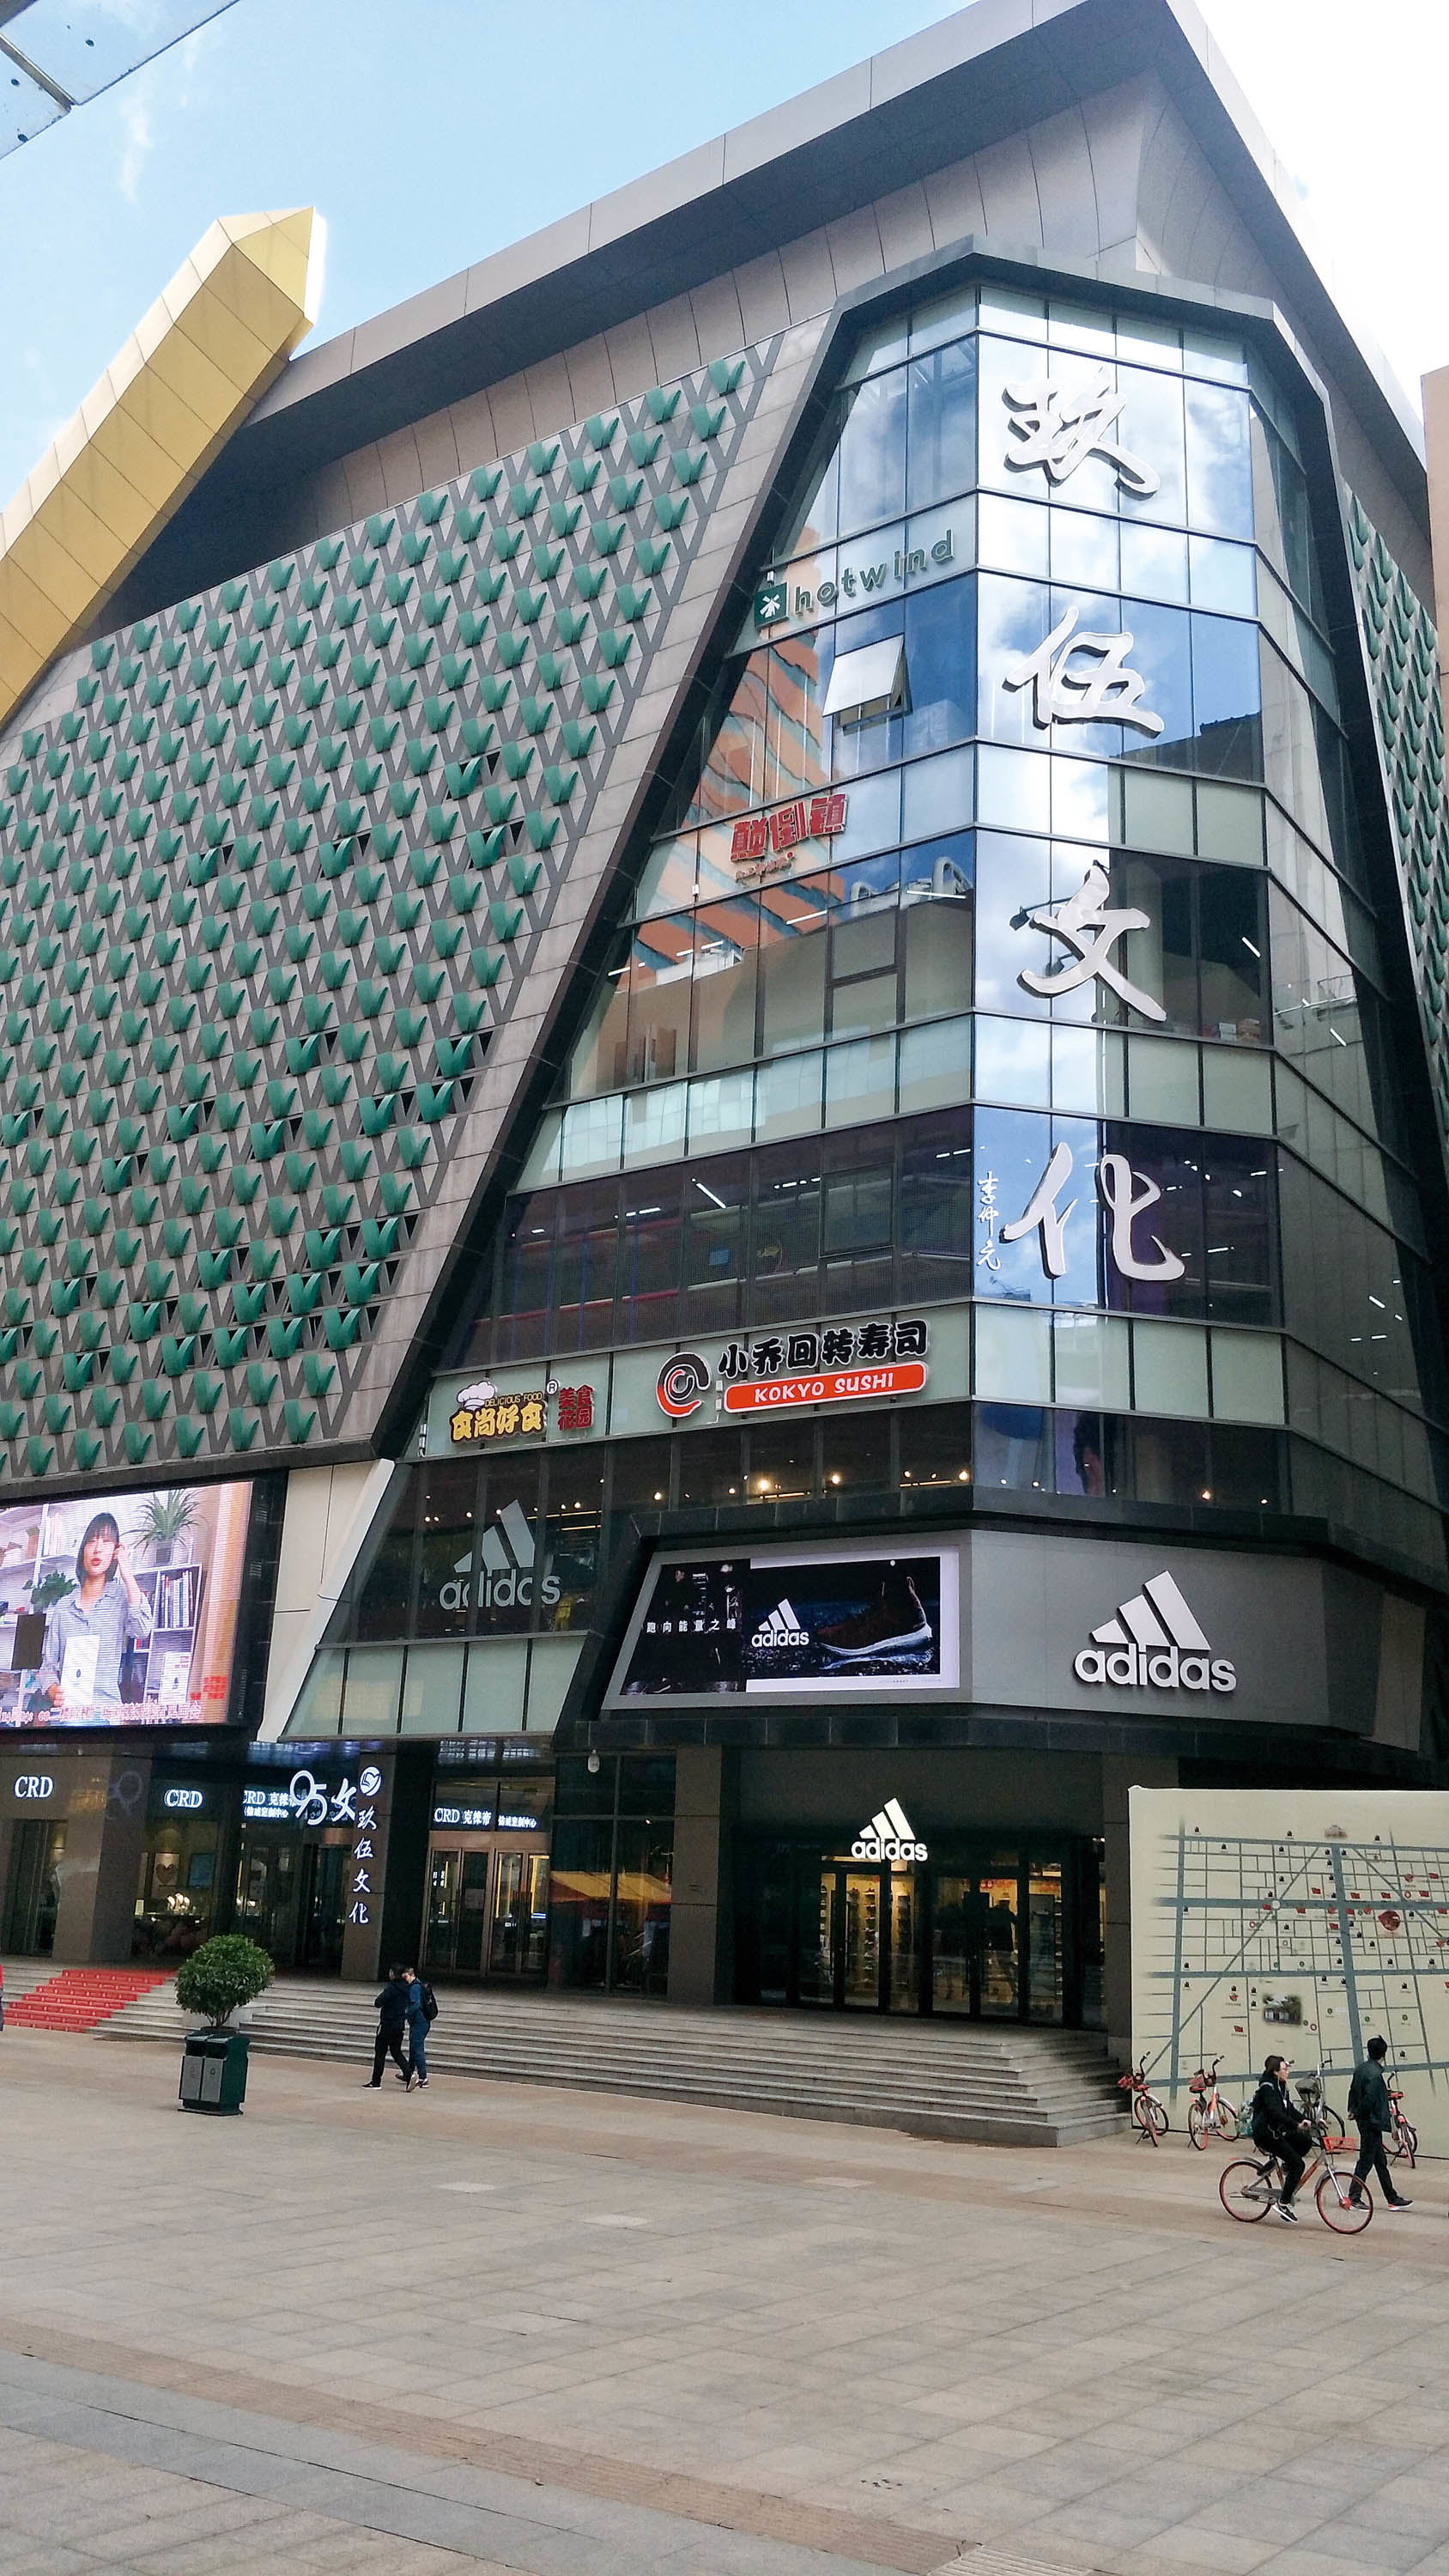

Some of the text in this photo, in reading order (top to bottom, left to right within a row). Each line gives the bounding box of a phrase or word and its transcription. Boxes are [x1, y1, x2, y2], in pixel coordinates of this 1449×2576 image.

[795, 529, 955, 616] hotwind
[718, 1320, 928, 1378] 小乔回转寿司
[484, 1392, 543, 1407] DELICIOUS FOOD
[755, 1373, 894, 1402] KOKYO SUSHI
[452, 1401, 543, 1441] 食尚好食
[751, 1628, 809, 1647] adidas
[1074, 1643, 1237, 1692] adidas
[14, 1775, 54, 1798] CRD
[164, 1789, 203, 1808] CRD
[433, 1807, 460, 1824] CRD
[851, 1837, 928, 1862] adidas
[349, 1805, 377, 1923] 玖伍文化
